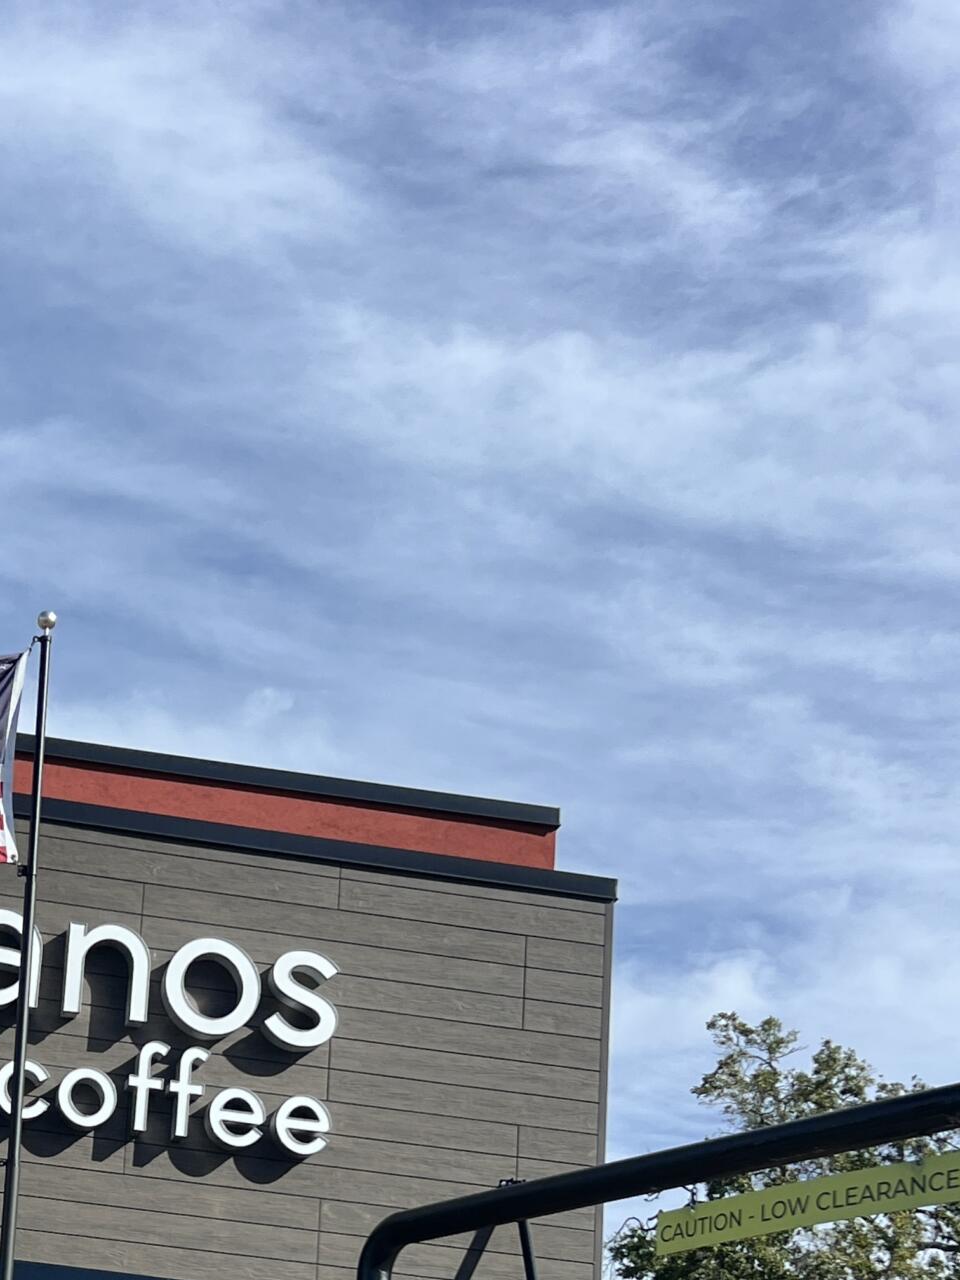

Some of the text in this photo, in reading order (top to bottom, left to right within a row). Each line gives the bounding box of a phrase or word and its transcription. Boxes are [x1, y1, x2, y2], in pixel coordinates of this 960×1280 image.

[660, 1208, 742, 1243] CAUTION
[761, 1194, 811, 1222] LOW
[815, 1168, 960, 1212] CLEARANCE
